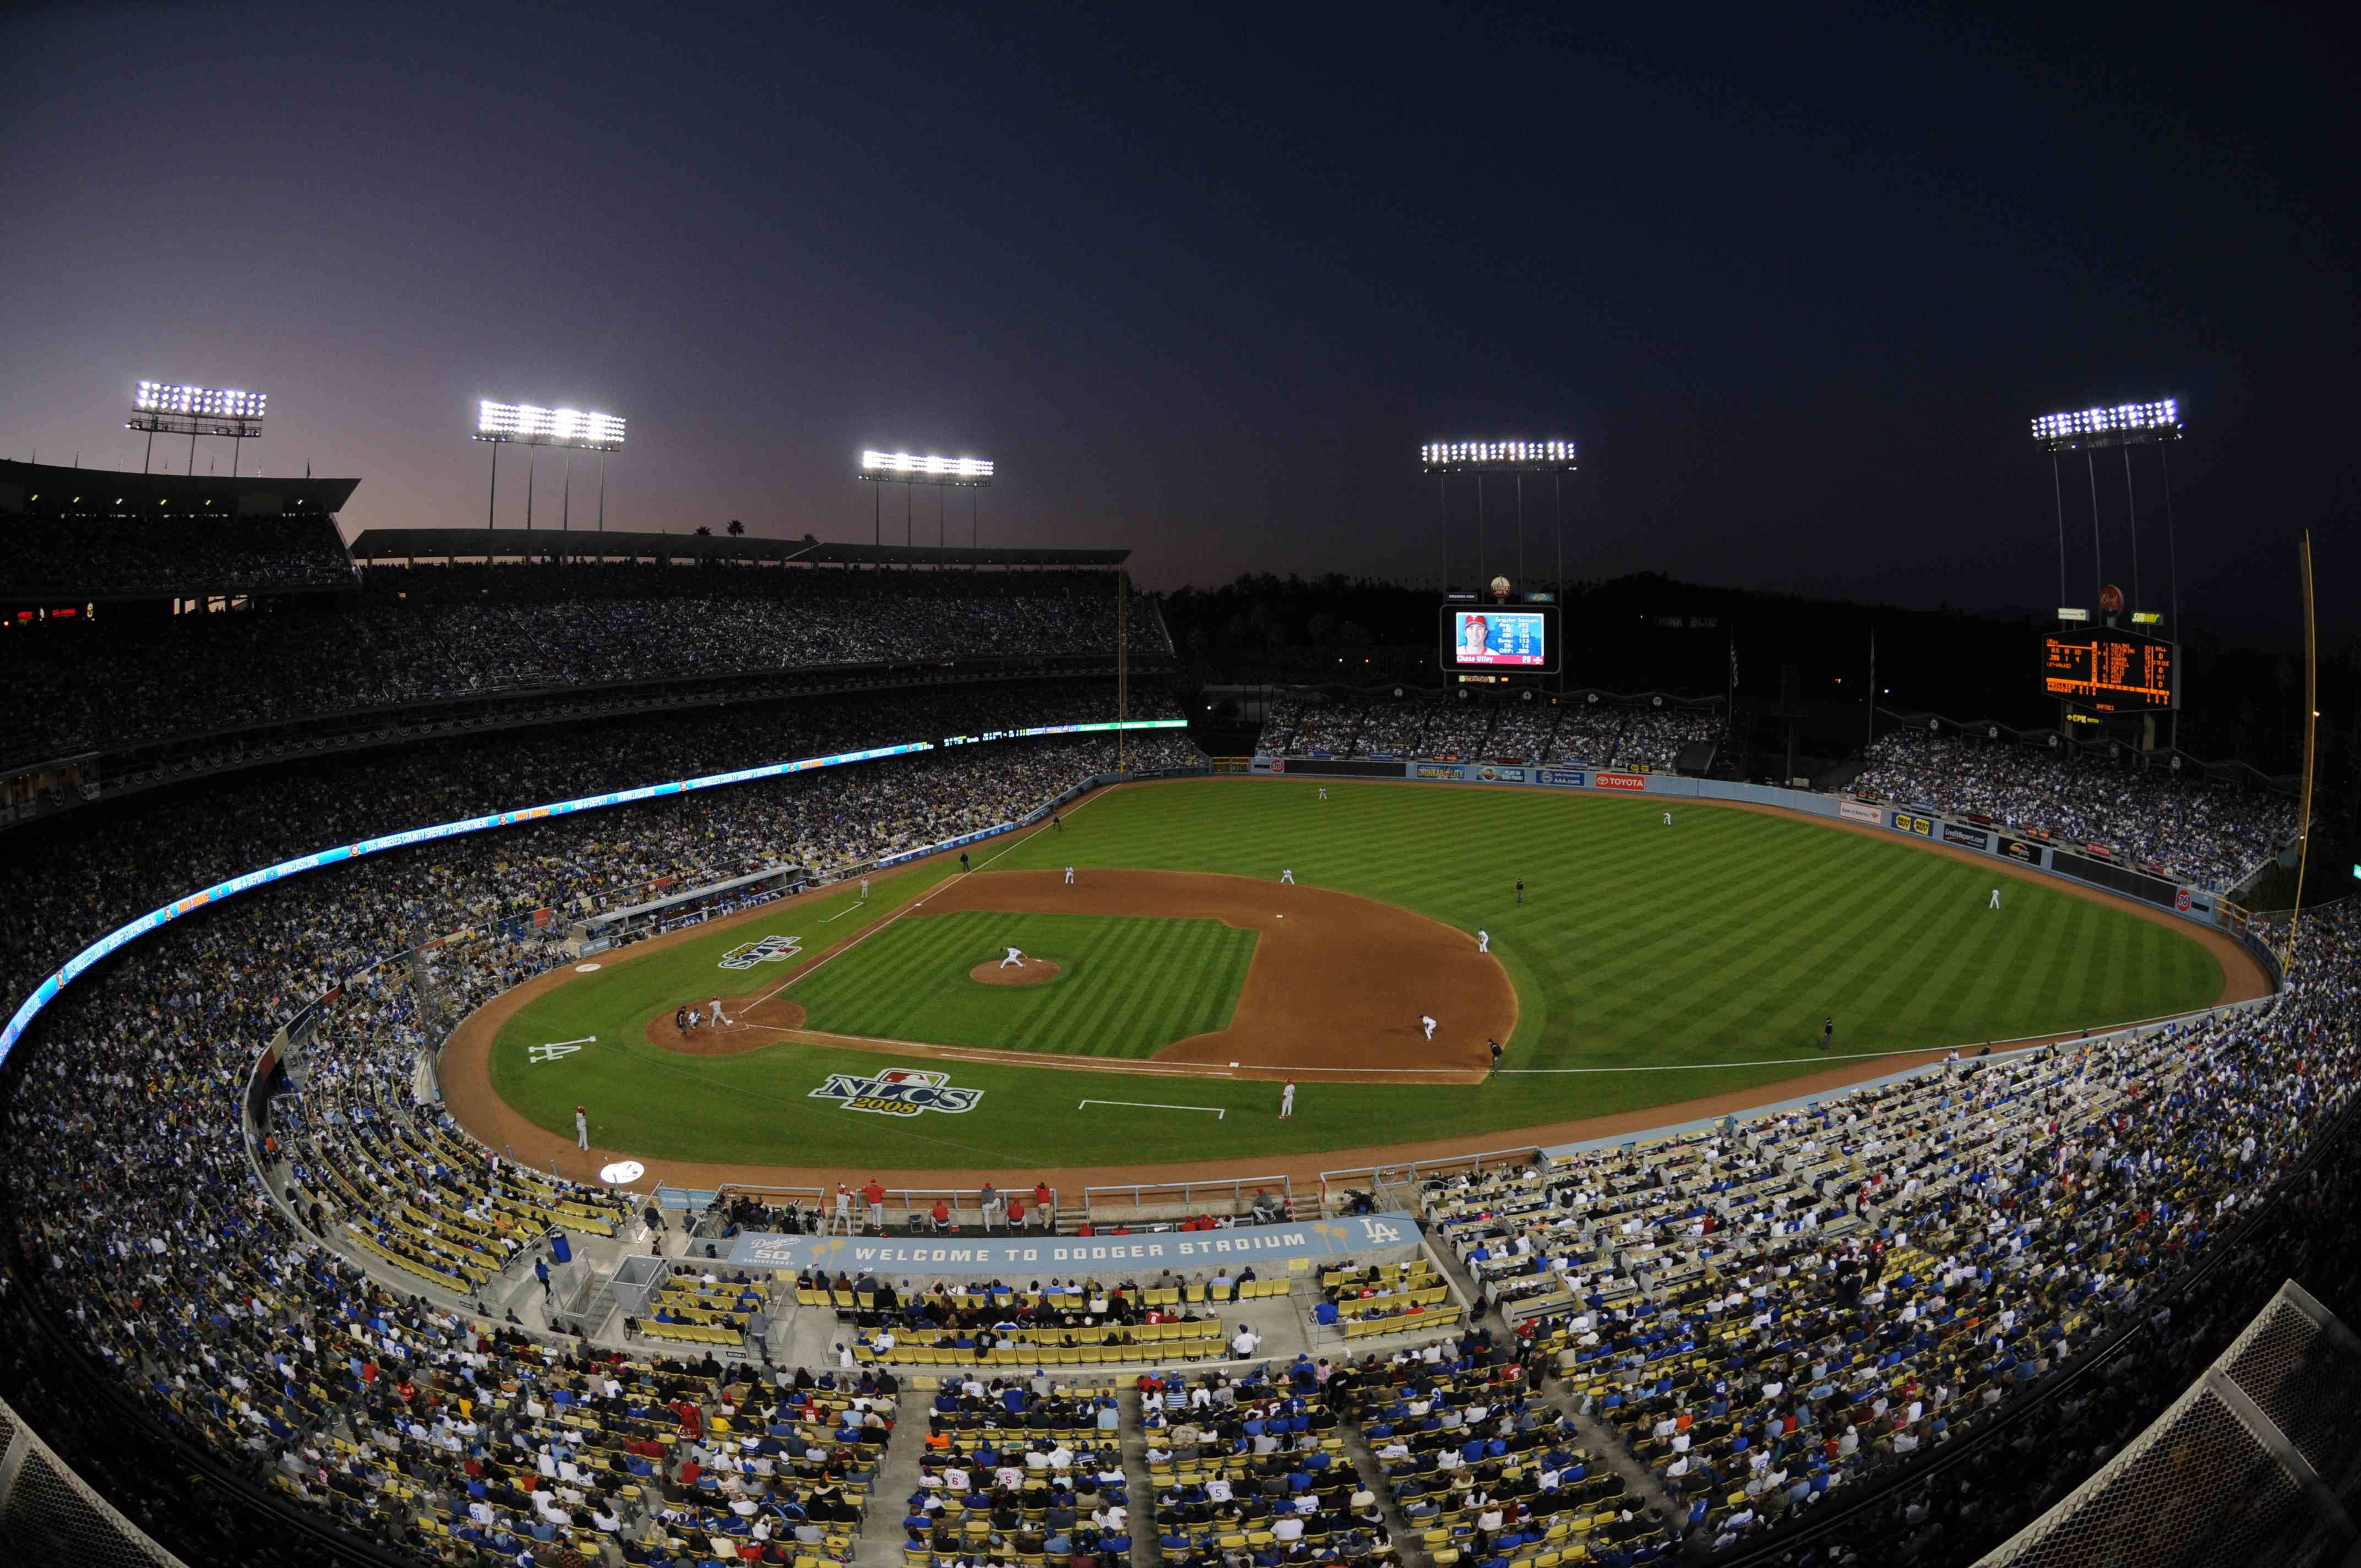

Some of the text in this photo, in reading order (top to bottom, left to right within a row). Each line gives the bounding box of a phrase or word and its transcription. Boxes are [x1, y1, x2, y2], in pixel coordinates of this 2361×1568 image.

[2132, 612, 2159, 623] SUBWAY
[1477, 655, 1493, 663] Utley
[1272, 761, 1283, 771] 76
[1418, 767, 1463, 778] DRINKABLITY
[1611, 777, 1643, 787] TOYOTA
[366, 819, 489, 852] LOS ANGELES COUNTY SHERIFF'S DEPARTMENT
[1945, 829, 1984, 843] CreditReport.com
[2093, 846, 2109, 855] TOYOTA
[2179, 896, 2189, 906] 76
[814, 1075, 979, 1112] NLCS
[853, 1098, 917, 1114] 2008
[1359, 1218, 1400, 1243] LA
[750, 1237, 801, 1250] Dodgers
[855, 1233, 1305, 1261] WELCOME TO DODGER STADIUM
[754, 1249, 791, 1260] 50
[952, 1477, 959, 1485] 6
[1005, 1476, 1012, 1484] 5
[1215, 1489, 1222, 1498] 5
